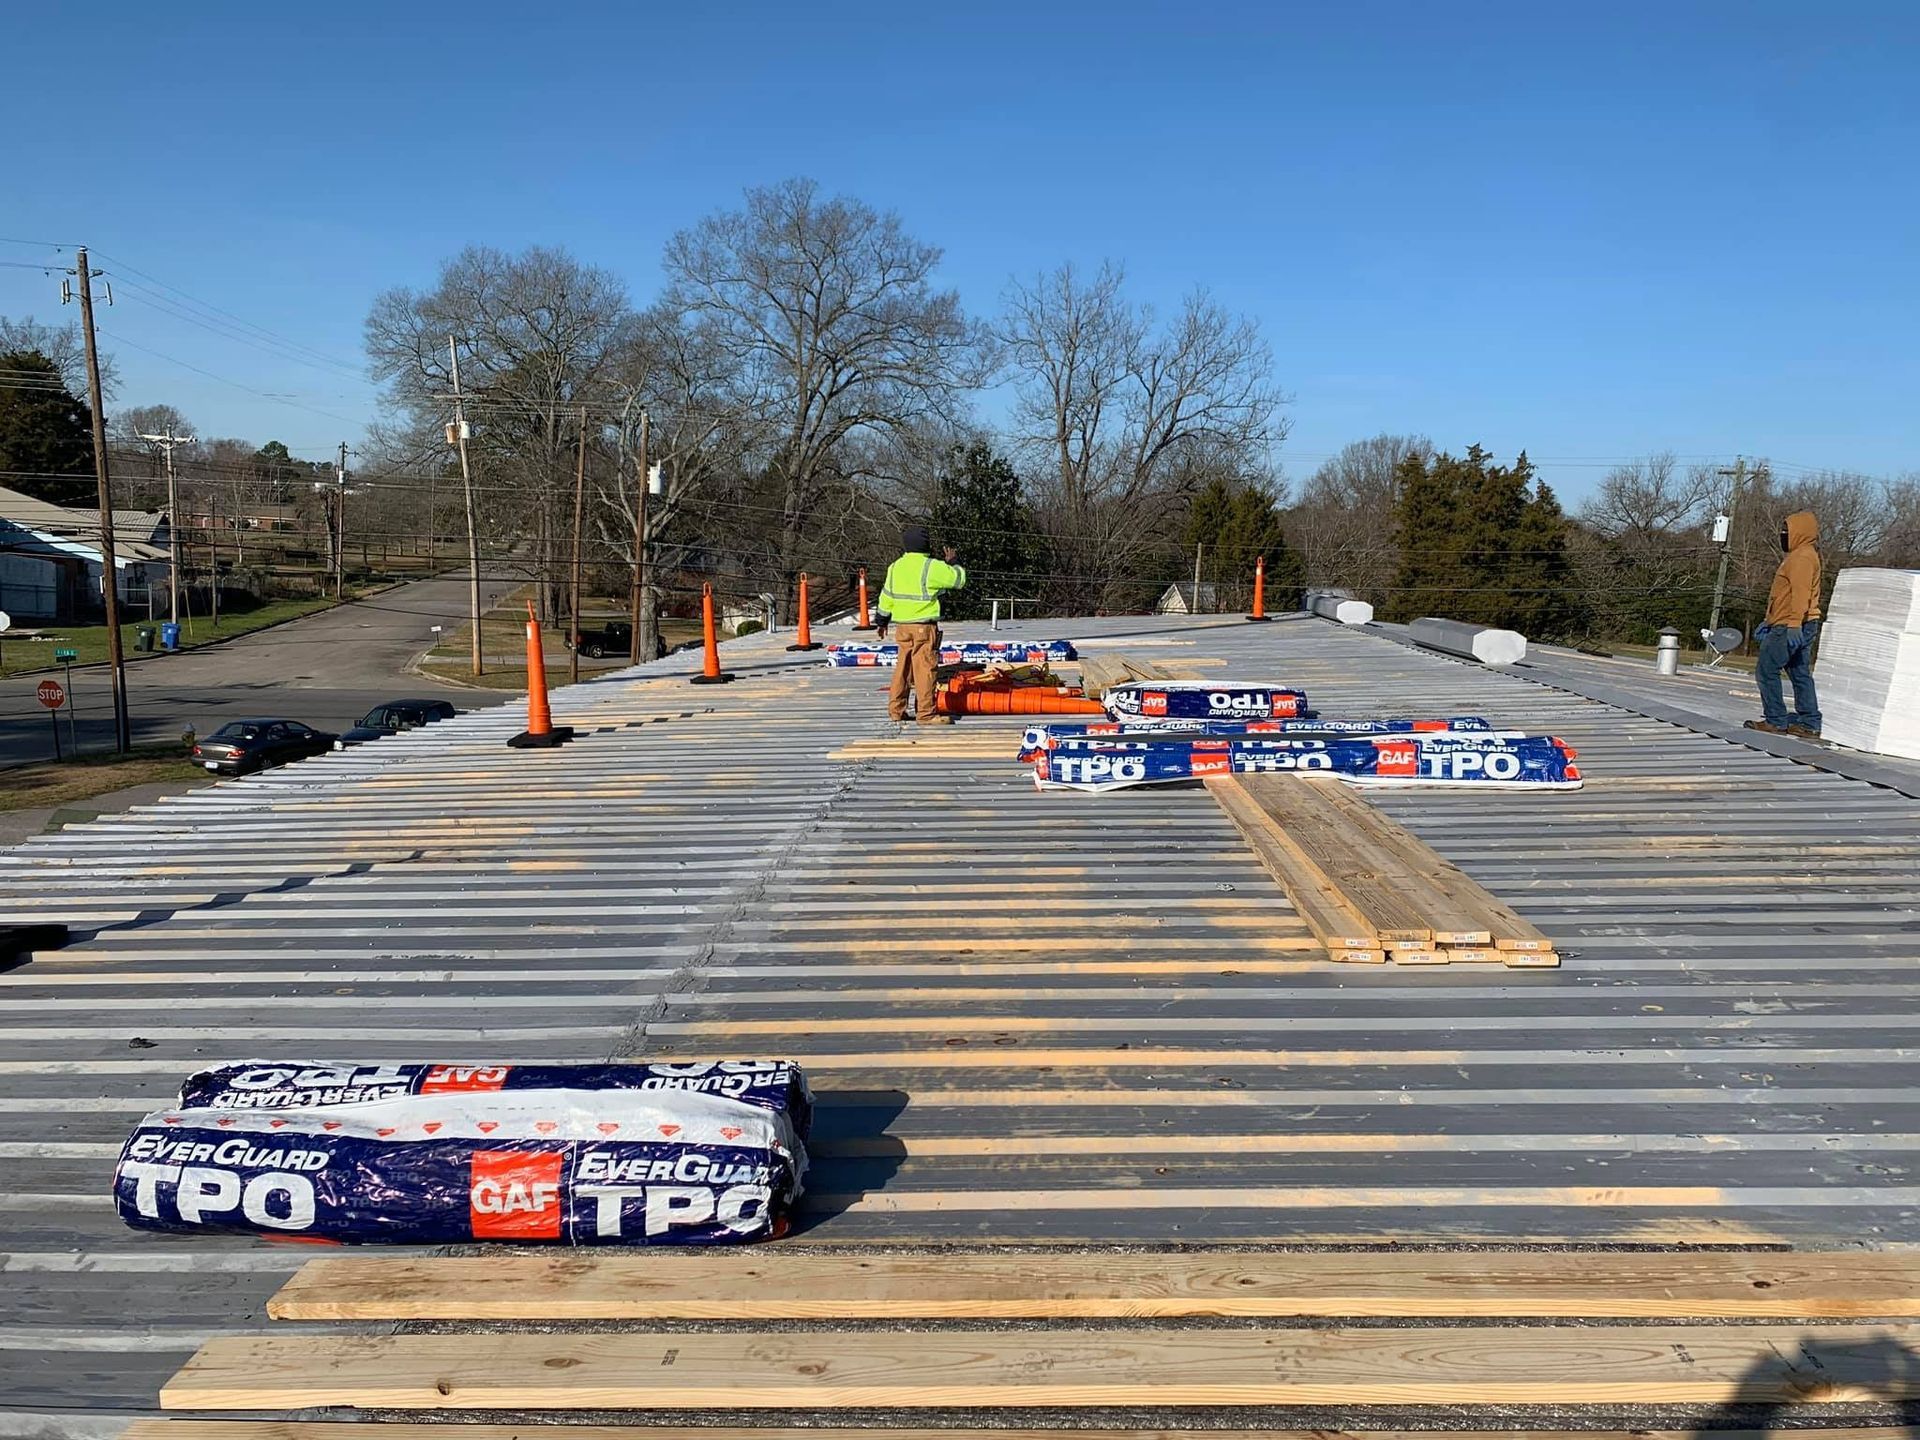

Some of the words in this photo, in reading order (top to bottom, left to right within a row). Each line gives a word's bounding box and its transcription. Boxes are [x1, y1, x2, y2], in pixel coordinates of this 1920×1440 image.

[39, 689, 63, 700] STOP
[1142, 697, 1167, 707] GAF
[1209, 692, 1270, 710] TPO
[1273, 700, 1297, 710] GAF
[1378, 750, 1415, 764] GAF
[1421, 752, 1520, 779] TPO
[1053, 760, 1146, 782] TPO
[129, 1134, 330, 1171] EVERGUARD
[120, 1160, 316, 1230] TPO
[471, 1179, 559, 1214] GAF
[574, 1184, 772, 1237] TPO
